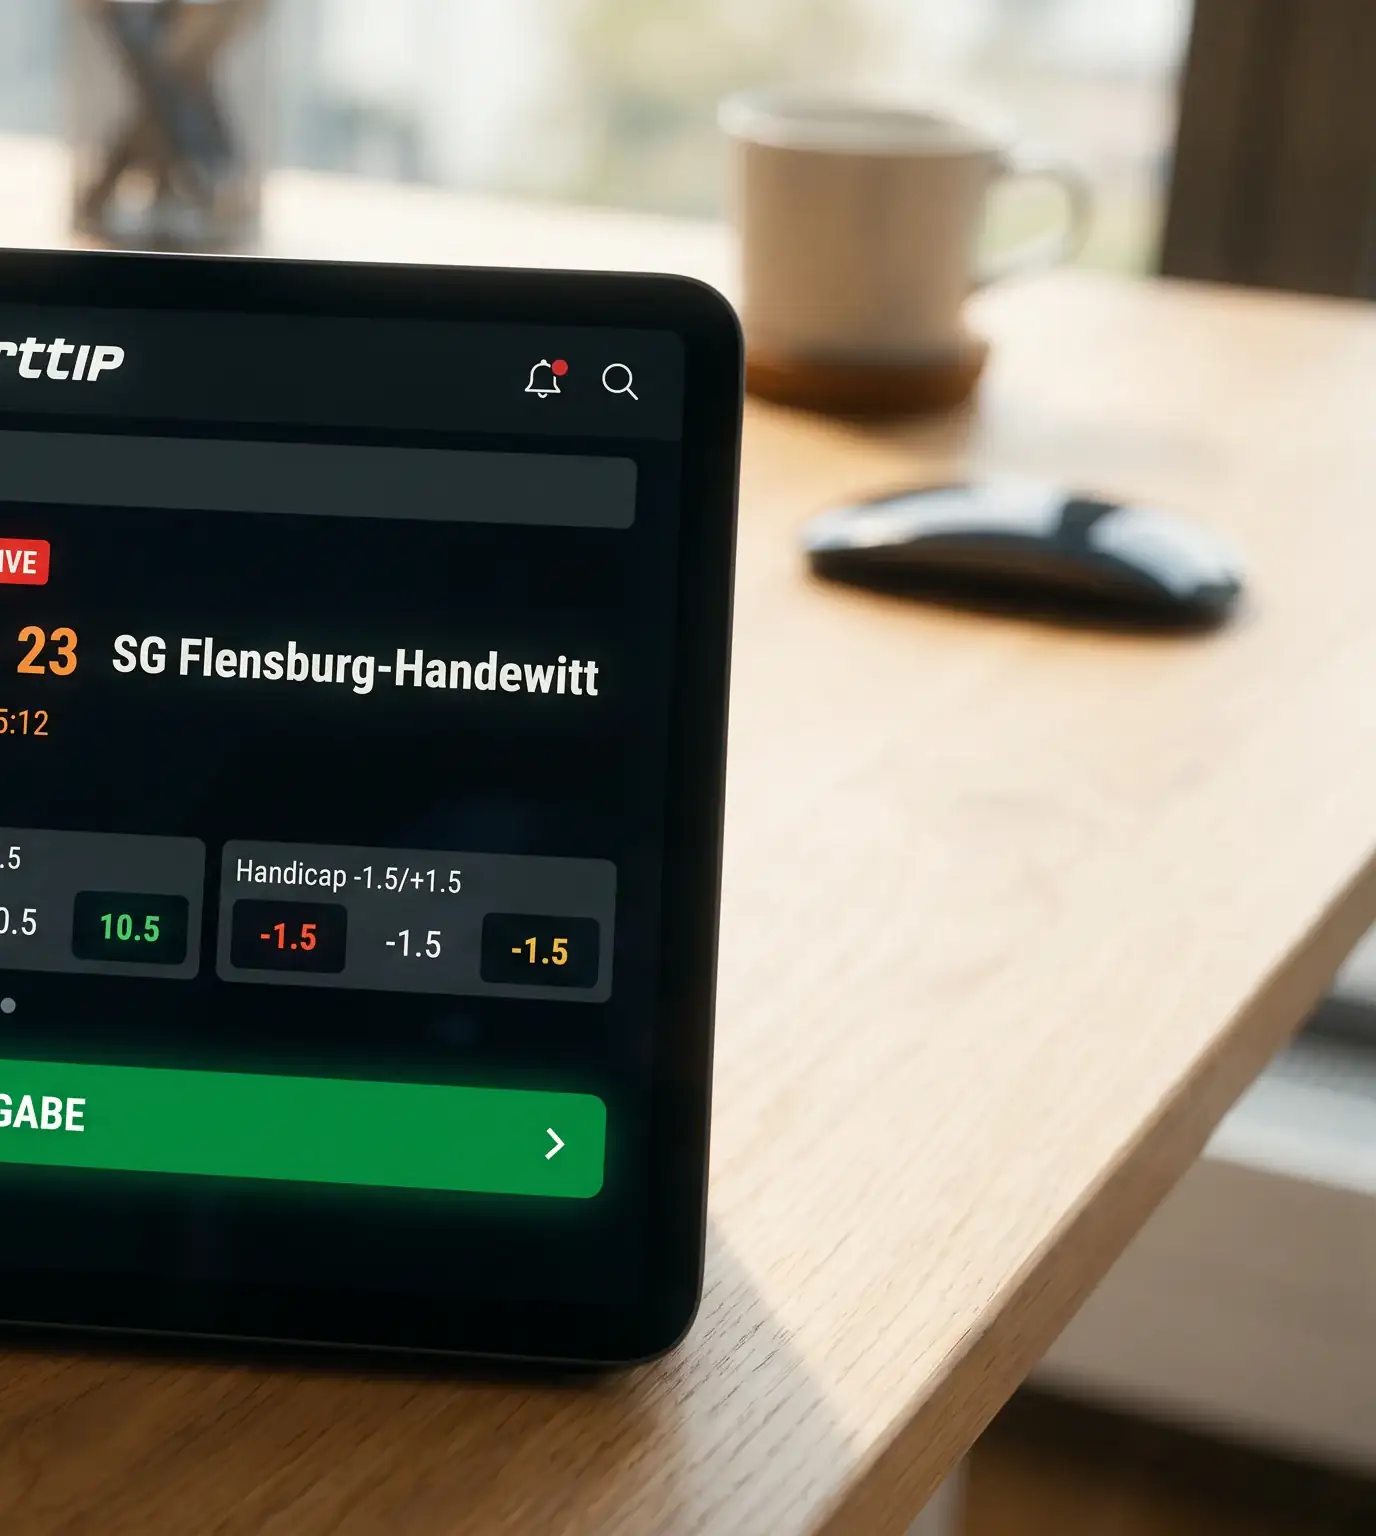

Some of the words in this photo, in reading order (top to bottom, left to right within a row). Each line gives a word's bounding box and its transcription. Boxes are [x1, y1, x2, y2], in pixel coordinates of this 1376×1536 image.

[17, 625, 78, 676] 23
[112, 634, 167, 674] SG
[179, 636, 599, 696] Flensburg-Handewitt
[236, 858, 347, 893] Handicap
[353, 865, 461, 894] -1.5/+1.5
[100, 913, 160, 942] 10.5
[260, 922, 317, 951] -1.5
[385, 929, 441, 959] -1.5
[511, 936, 568, 966] -1.5
